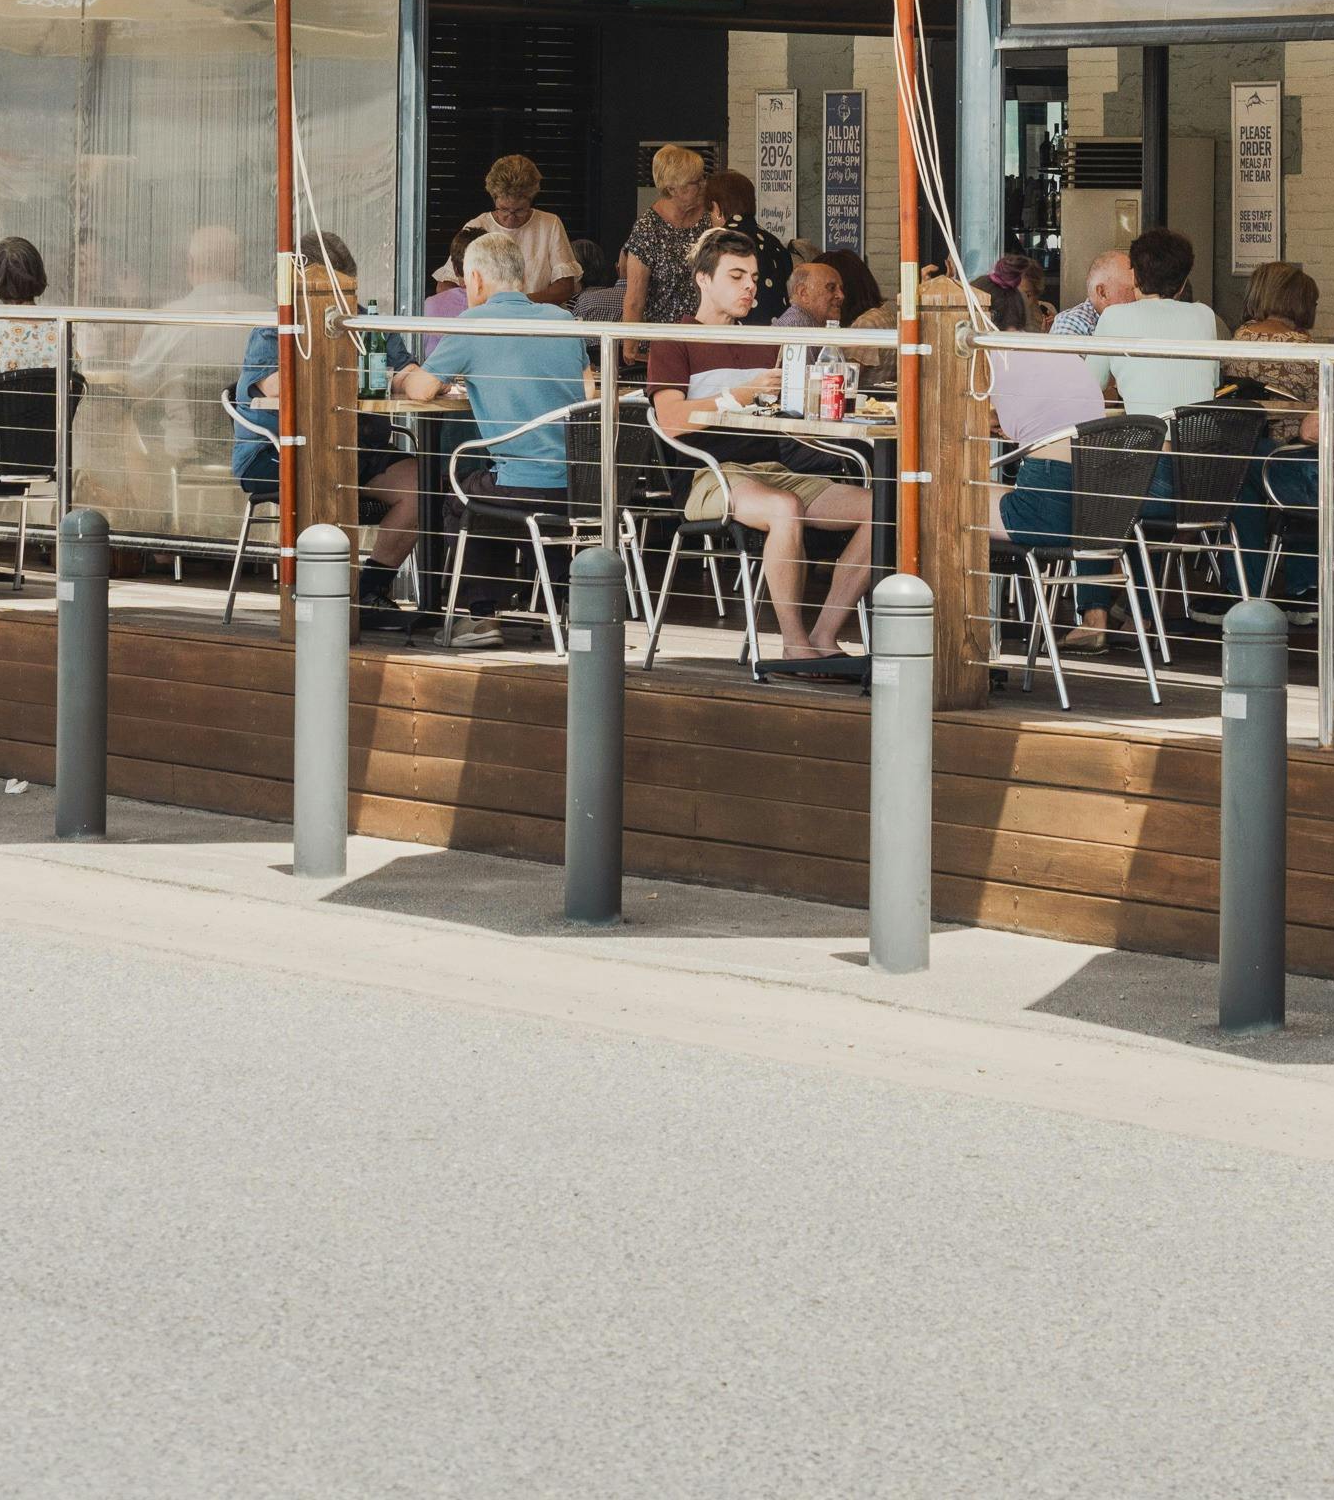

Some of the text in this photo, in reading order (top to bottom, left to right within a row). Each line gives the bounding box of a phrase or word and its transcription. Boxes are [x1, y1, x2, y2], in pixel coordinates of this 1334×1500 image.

[760, 131, 793, 144] SENIORS
[828, 125, 860, 140] ALL DAY
[1240, 126, 1271, 140] PLEASE
[827, 140, 860, 154] DINING
[1240, 141, 1272, 156] ORDER
[761, 145, 792, 167] 20%
[827, 156, 860, 167] 12PM-9PM
[1240, 158, 1272, 169] MEALS AT
[761, 170, 792, 181] DISCOUNT
[1240, 170, 1271, 182] THE BAR
[761, 182, 792, 192] FOR LUNCH
[827, 195, 860, 205] BREAKFAST
[827, 206, 859, 217] 9AM-11AM
[1240, 210, 1272, 221] SEE STAFF
[1240, 222, 1273, 232] FOR MENU
